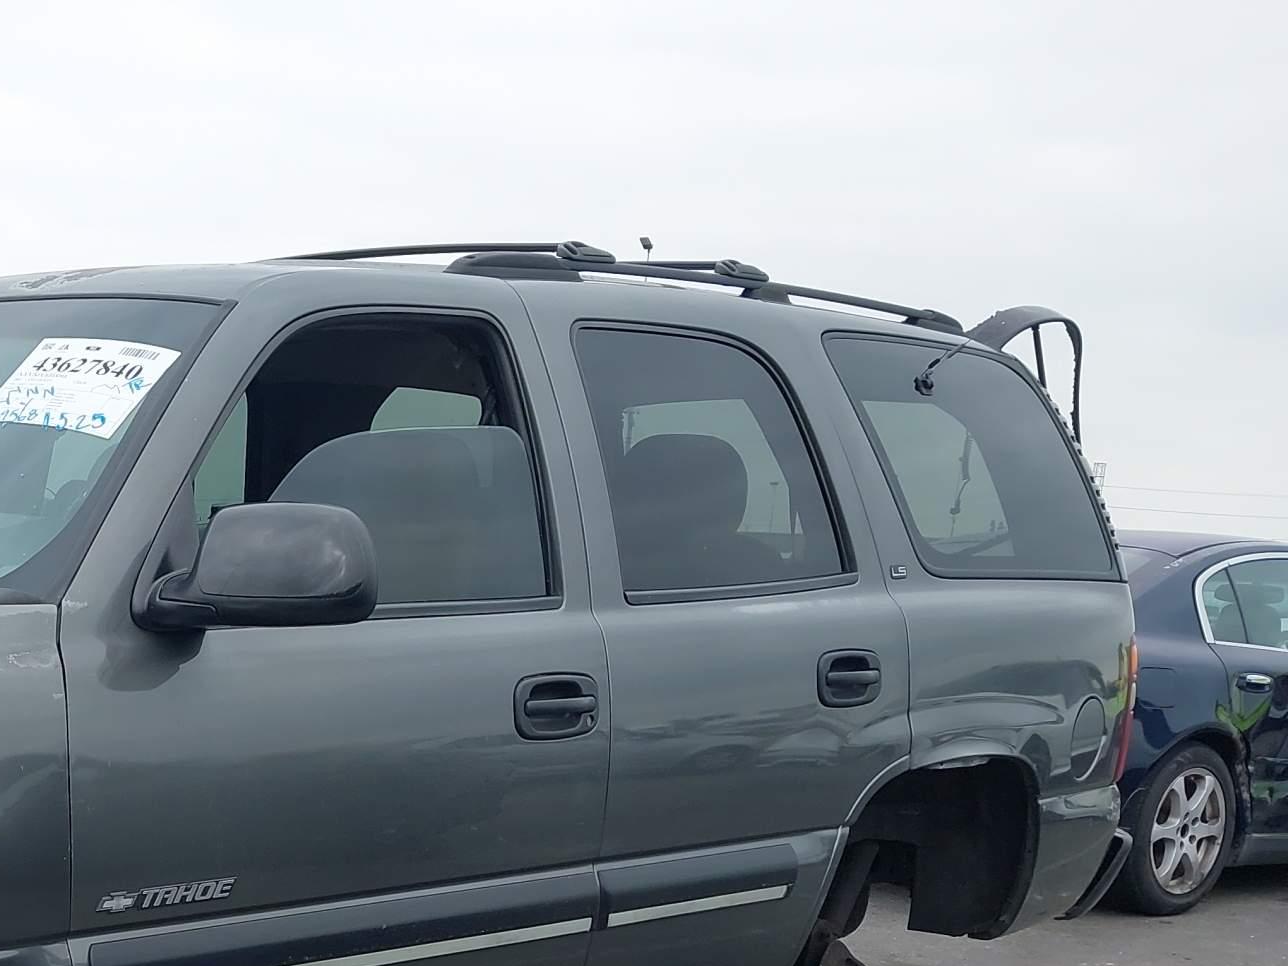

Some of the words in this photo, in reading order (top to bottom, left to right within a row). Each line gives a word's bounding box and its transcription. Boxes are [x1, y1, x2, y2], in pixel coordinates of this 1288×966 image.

[33, 356, 143, 380] 43627840
[891, 566, 907, 577] LS
[141, 878, 236, 909] TAHOE
